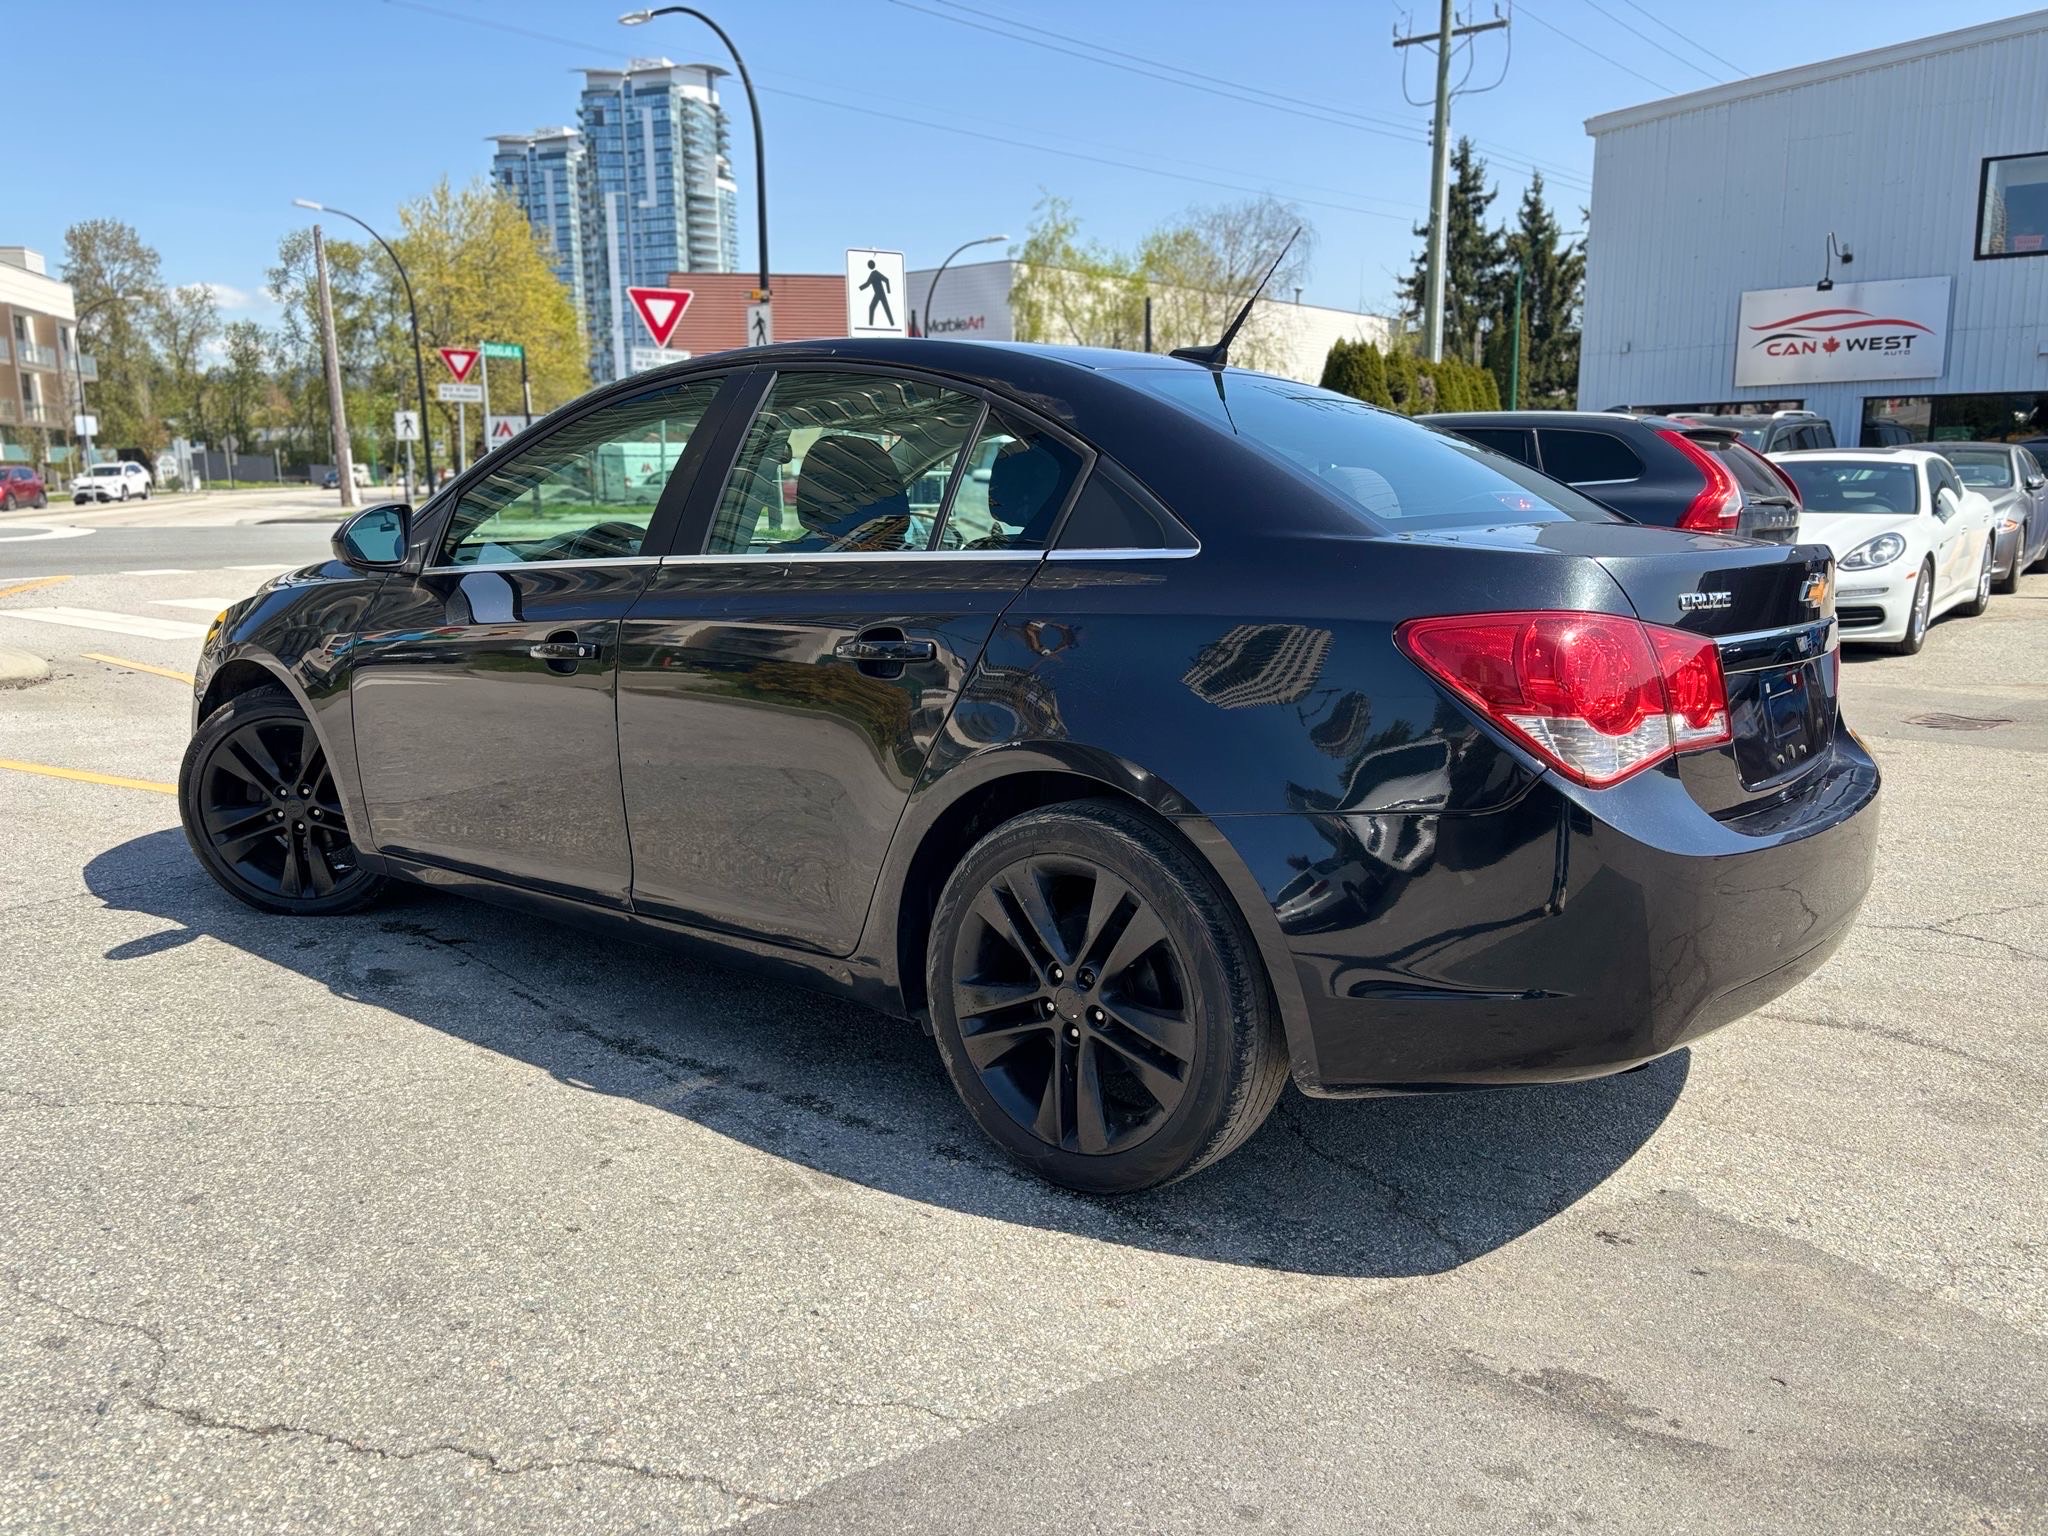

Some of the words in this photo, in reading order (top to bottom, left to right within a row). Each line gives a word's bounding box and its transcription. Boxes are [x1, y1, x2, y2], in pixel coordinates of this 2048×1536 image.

[1767, 341, 1817, 356] CAN
[1846, 335, 1918, 351] WEST
[1679, 592, 1732, 611] CRUZE
